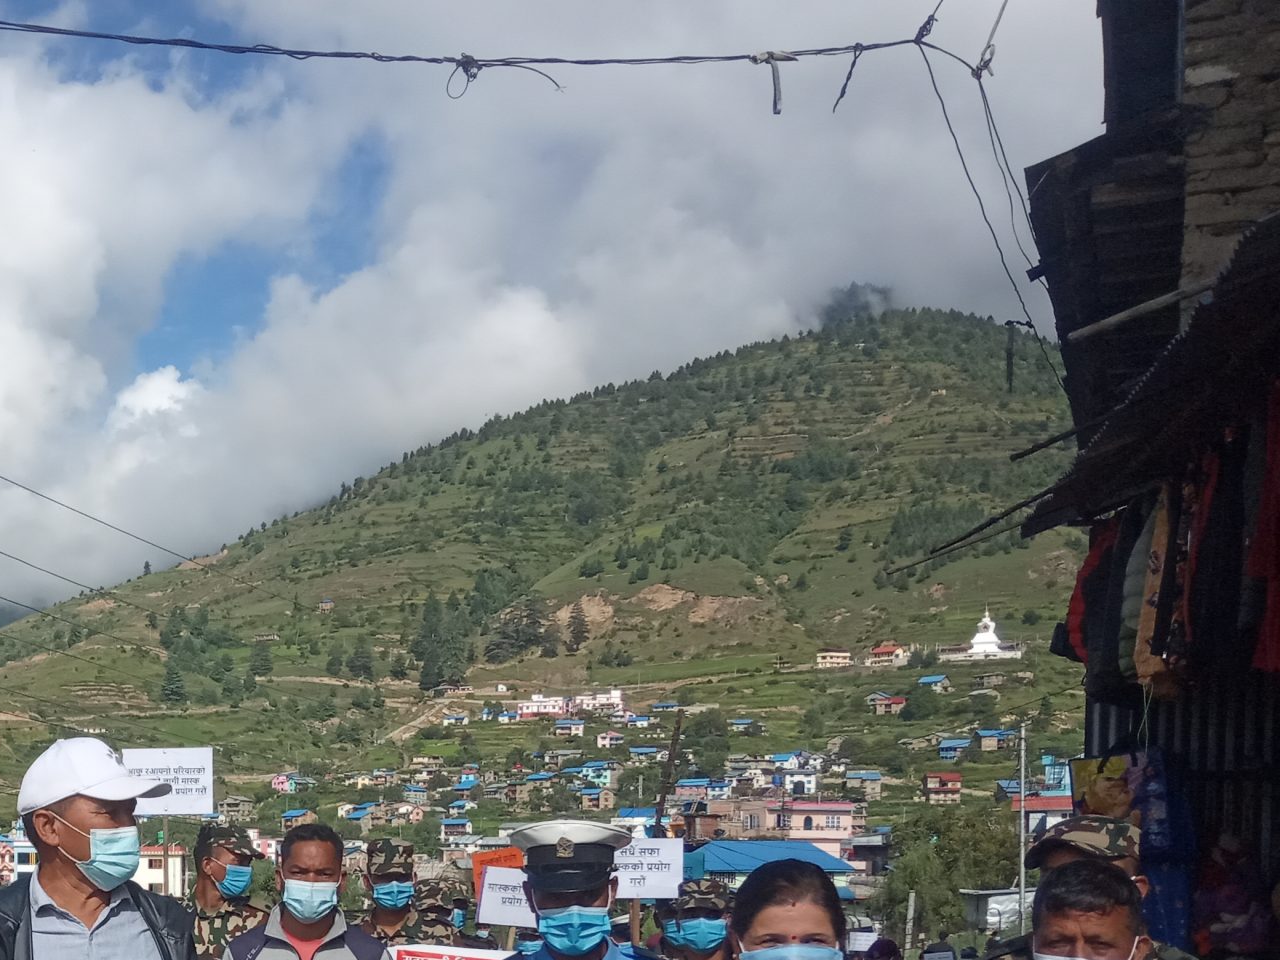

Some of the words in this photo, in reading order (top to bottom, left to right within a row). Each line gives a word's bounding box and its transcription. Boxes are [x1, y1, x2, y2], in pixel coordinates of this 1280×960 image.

[181, 777, 200, 785] मास्क
[638, 847, 660, 856] सफा
[646, 860, 671, 871] प्रयोग
[501, 895, 522, 905] प्रयोग
